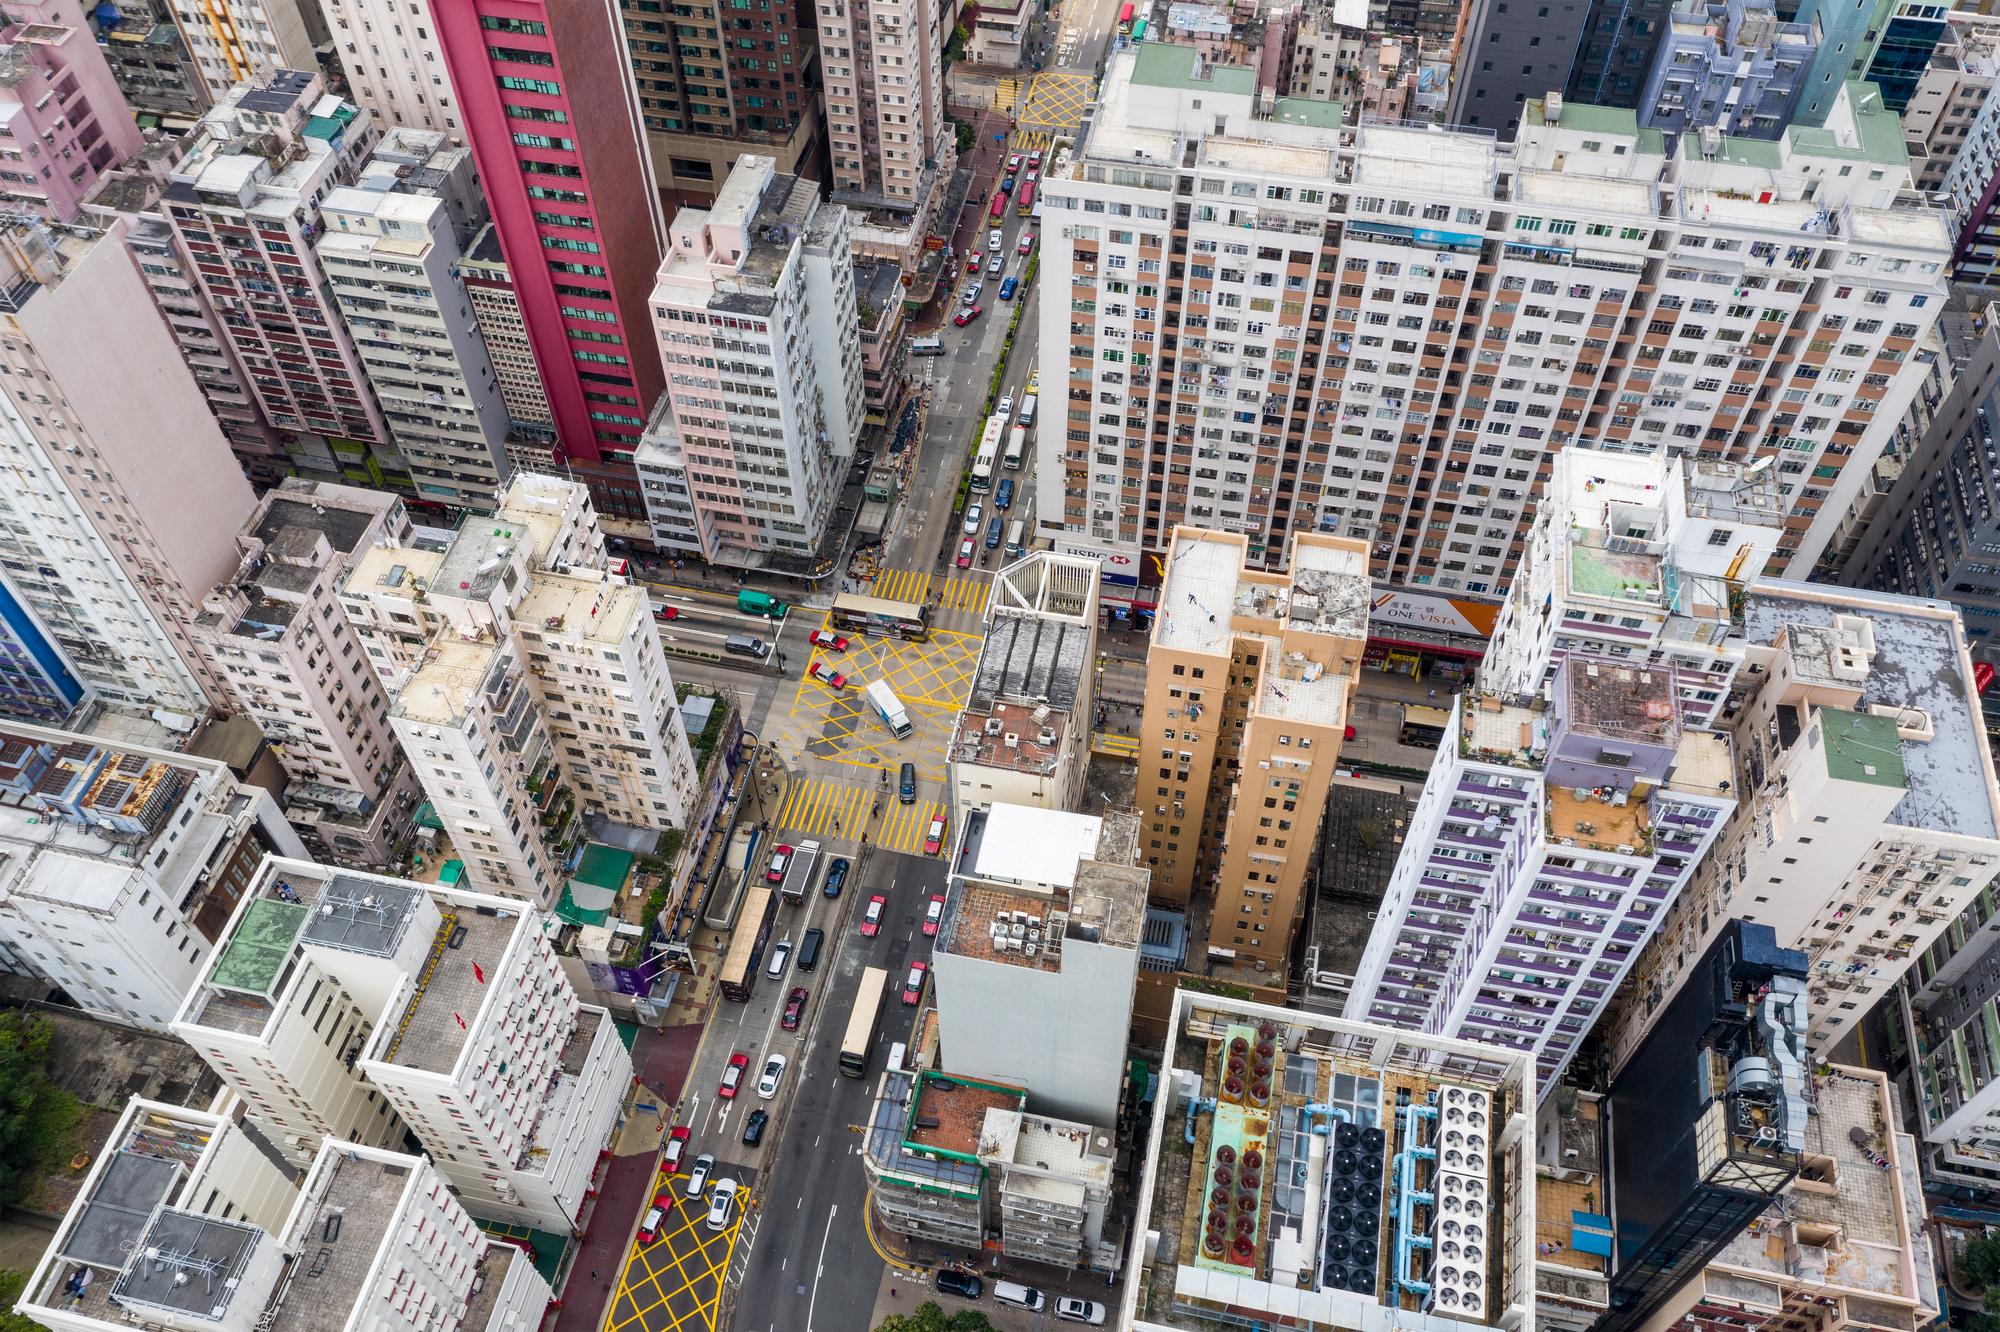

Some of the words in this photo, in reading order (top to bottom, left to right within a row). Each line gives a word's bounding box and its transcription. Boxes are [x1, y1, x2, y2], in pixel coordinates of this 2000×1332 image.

[1067, 548, 1108, 562] HSBC
[1388, 608, 1416, 620] ONE
[1418, 613, 1456, 626] VISTA
[902, 1276, 917, 1284] RIGHT
